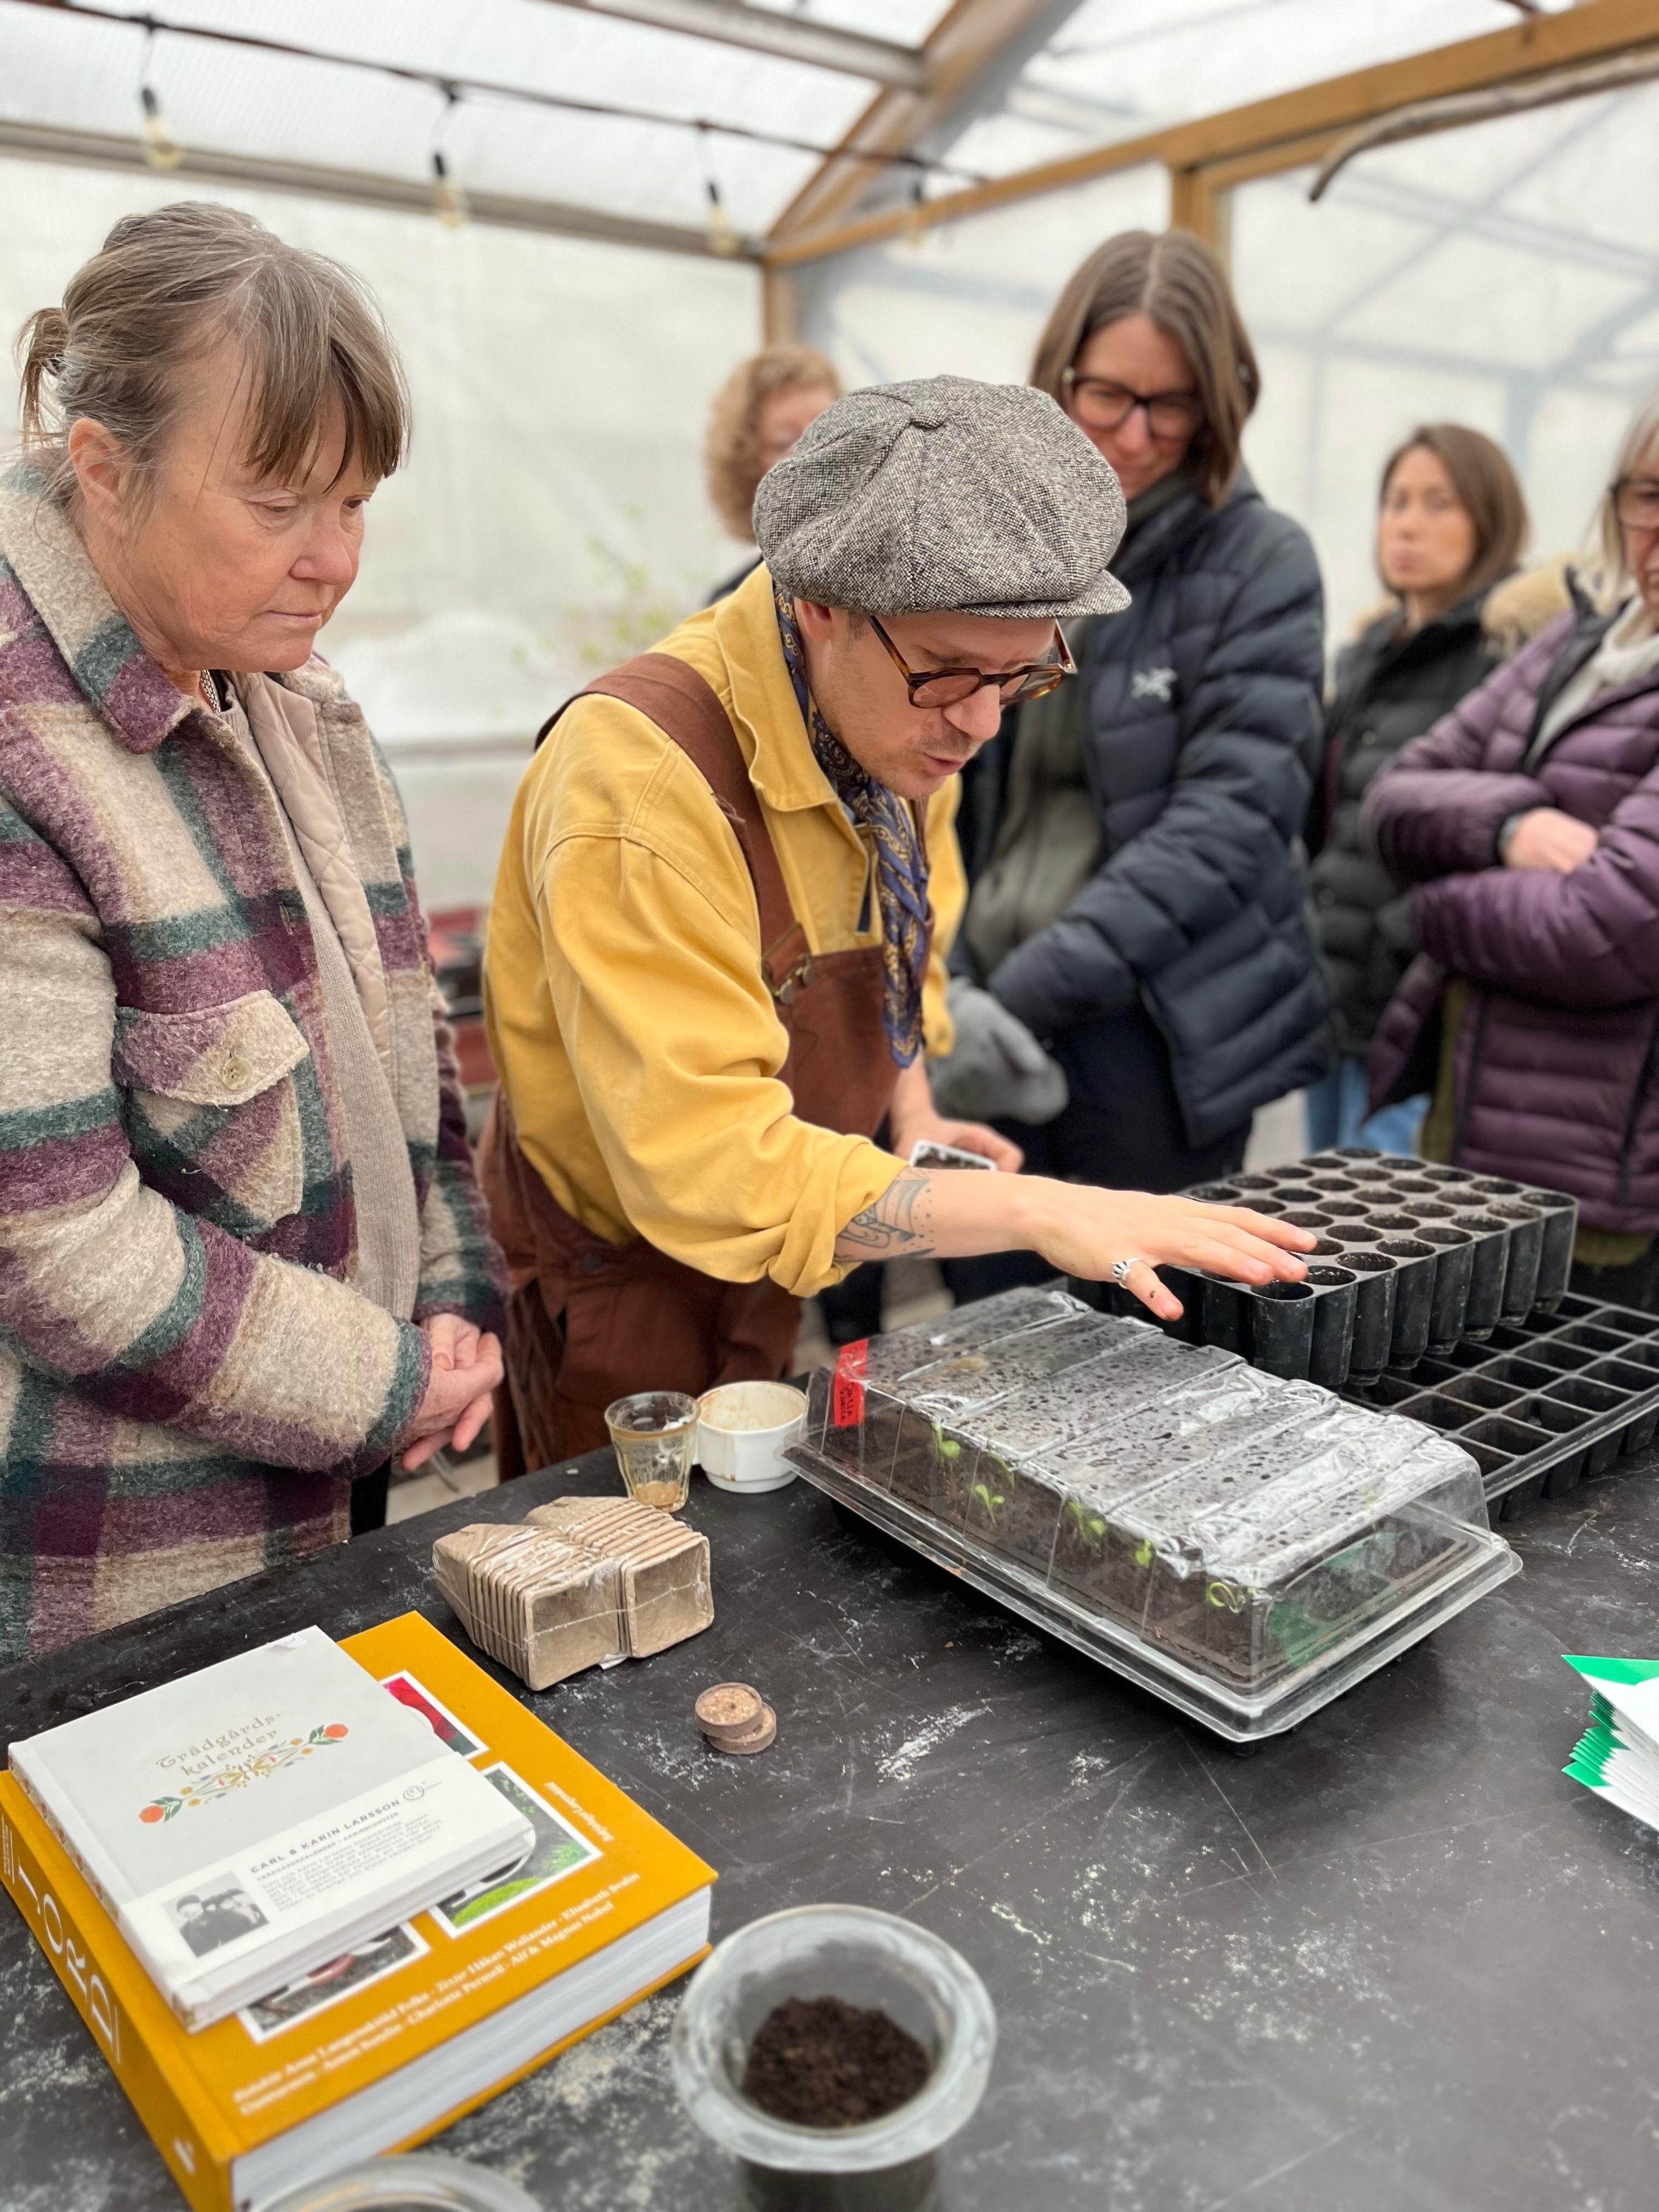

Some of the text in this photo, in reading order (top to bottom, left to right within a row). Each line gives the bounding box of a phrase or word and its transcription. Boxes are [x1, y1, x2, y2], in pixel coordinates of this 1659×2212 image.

[155, 1713, 281, 1769] Trädgårds-
[180, 1729, 277, 1776] kalender
[250, 1798, 400, 1874] CARL & KARIN LARSSON
[504, 1920, 557, 1952] Wallander
[540, 1921, 582, 1948] Magnus
[582, 1902, 613, 1923] Nobel
[18, 1857, 114, 2052] JORD
